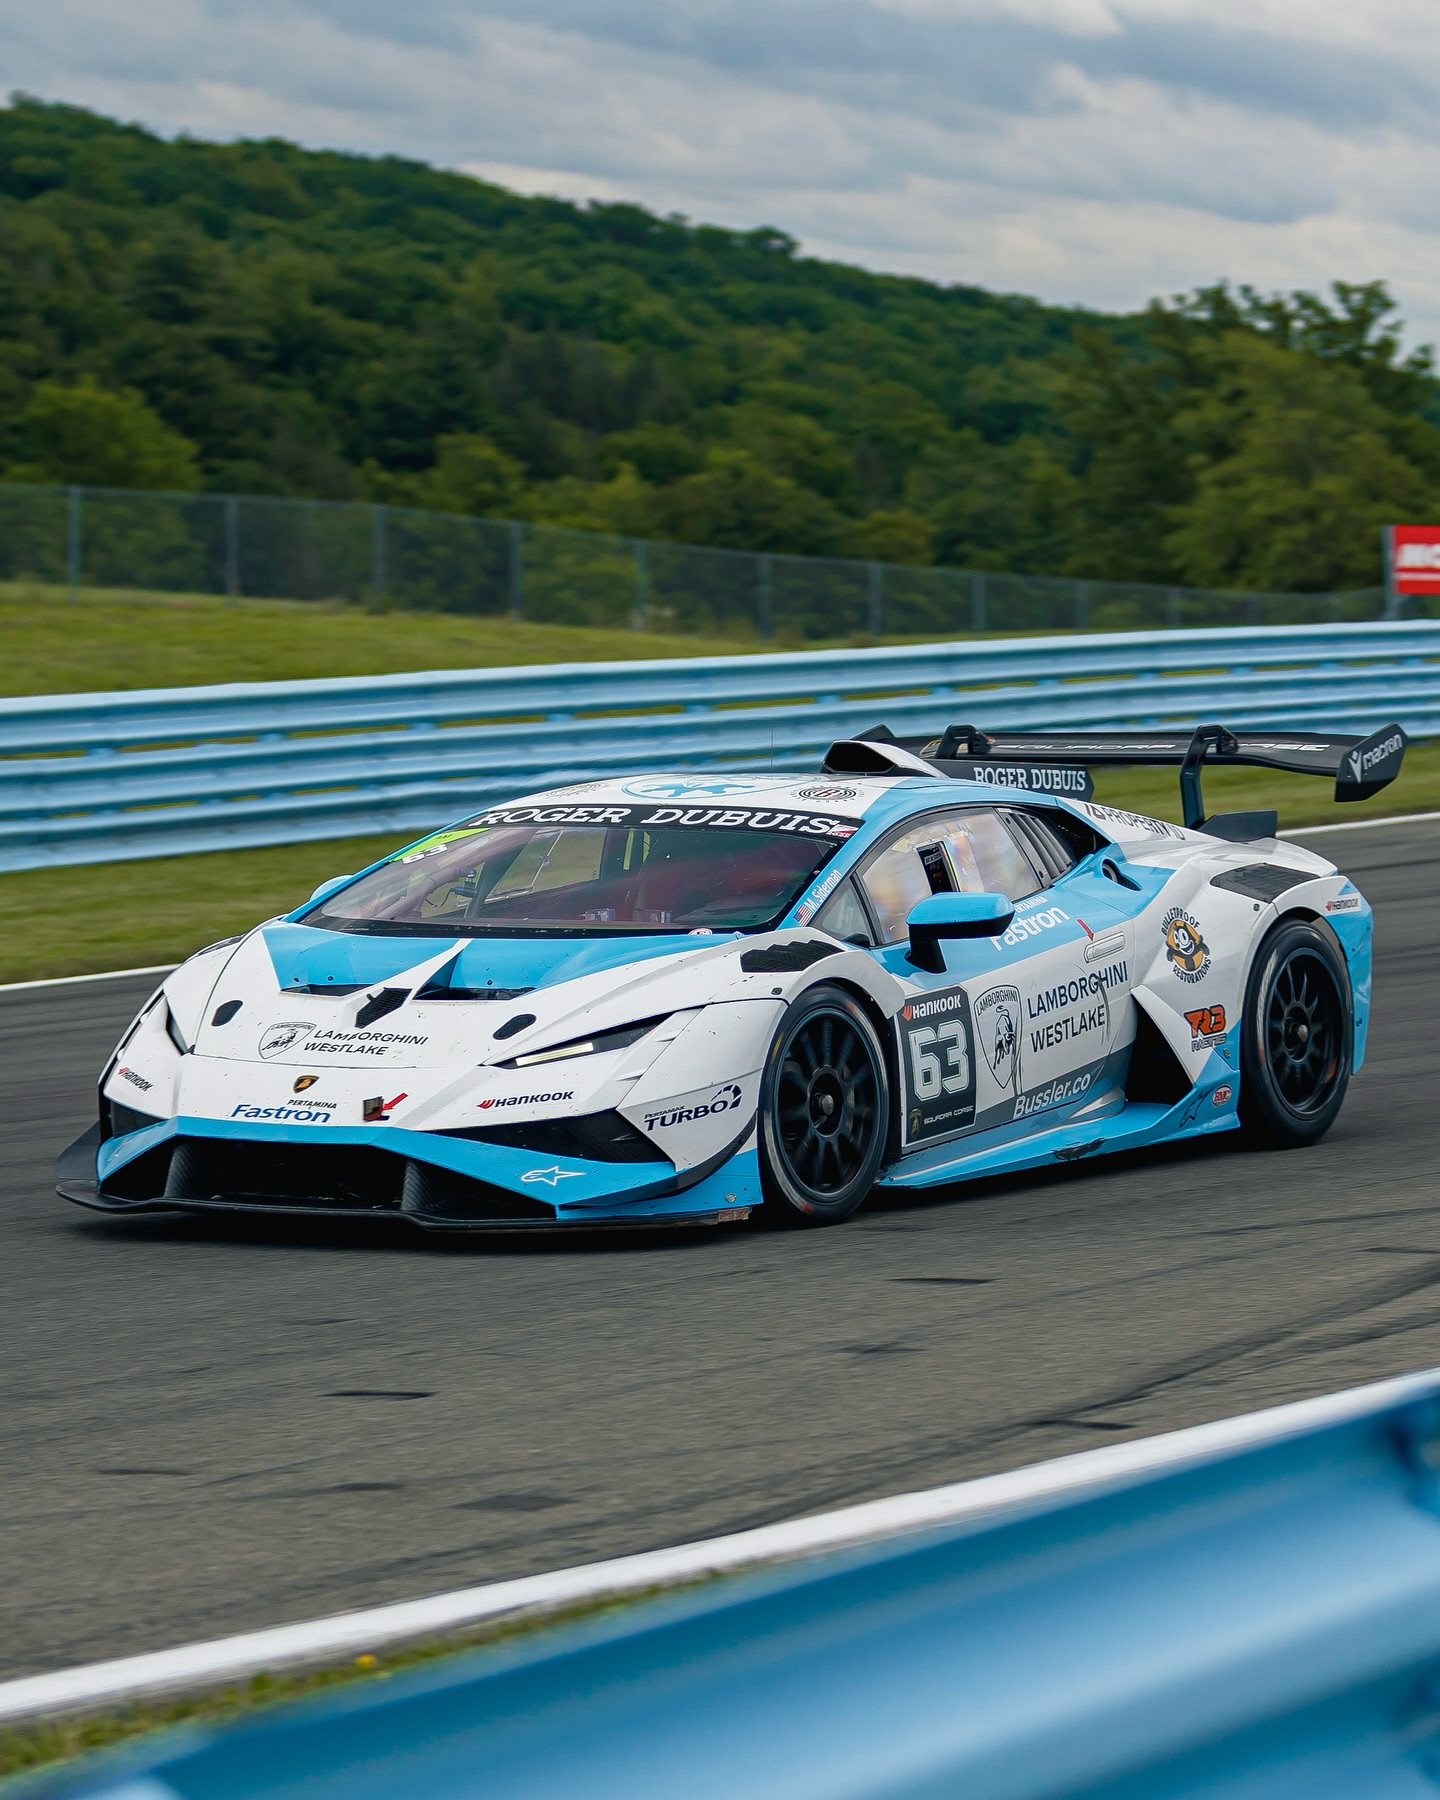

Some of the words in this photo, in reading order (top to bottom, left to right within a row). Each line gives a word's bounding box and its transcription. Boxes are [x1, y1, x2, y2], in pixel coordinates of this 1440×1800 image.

[1363, 734, 1403, 770] macron
[973, 767, 1028, 789] ROGER
[1031, 769, 1086, 792] DUBUIS
[468, 808, 632, 828] ROGER
[641, 808, 841, 834] DUBUIS
[1101, 807, 1171, 836] PROPERTY
[402, 843, 448, 865] 63
[811, 868, 843, 902] Siderman
[804, 897, 820, 912] M.
[1161, 906, 1200, 937] BULLETPROOF
[1172, 957, 1211, 984] RESTORATIONS
[976, 989, 1018, 1017] LAMBORGHINI
[1027, 961, 1128, 1018] LAMBORGHINI
[313, 1030, 429, 1046] LAMBORGHINI
[1030, 1004, 1105, 1053] WESTLAKE
[303, 1042, 389, 1056] WESTLAKE
[908, 1018, 970, 1102] 63
[286, 1099, 338, 1109] PERTAMINA
[1012, 1072, 1091, 1120] Bussler.co
[230, 1104, 331, 1123] Fastron
[643, 1100, 728, 1131] TURBO
[644, 1105, 685, 1119] PERTAMAX
